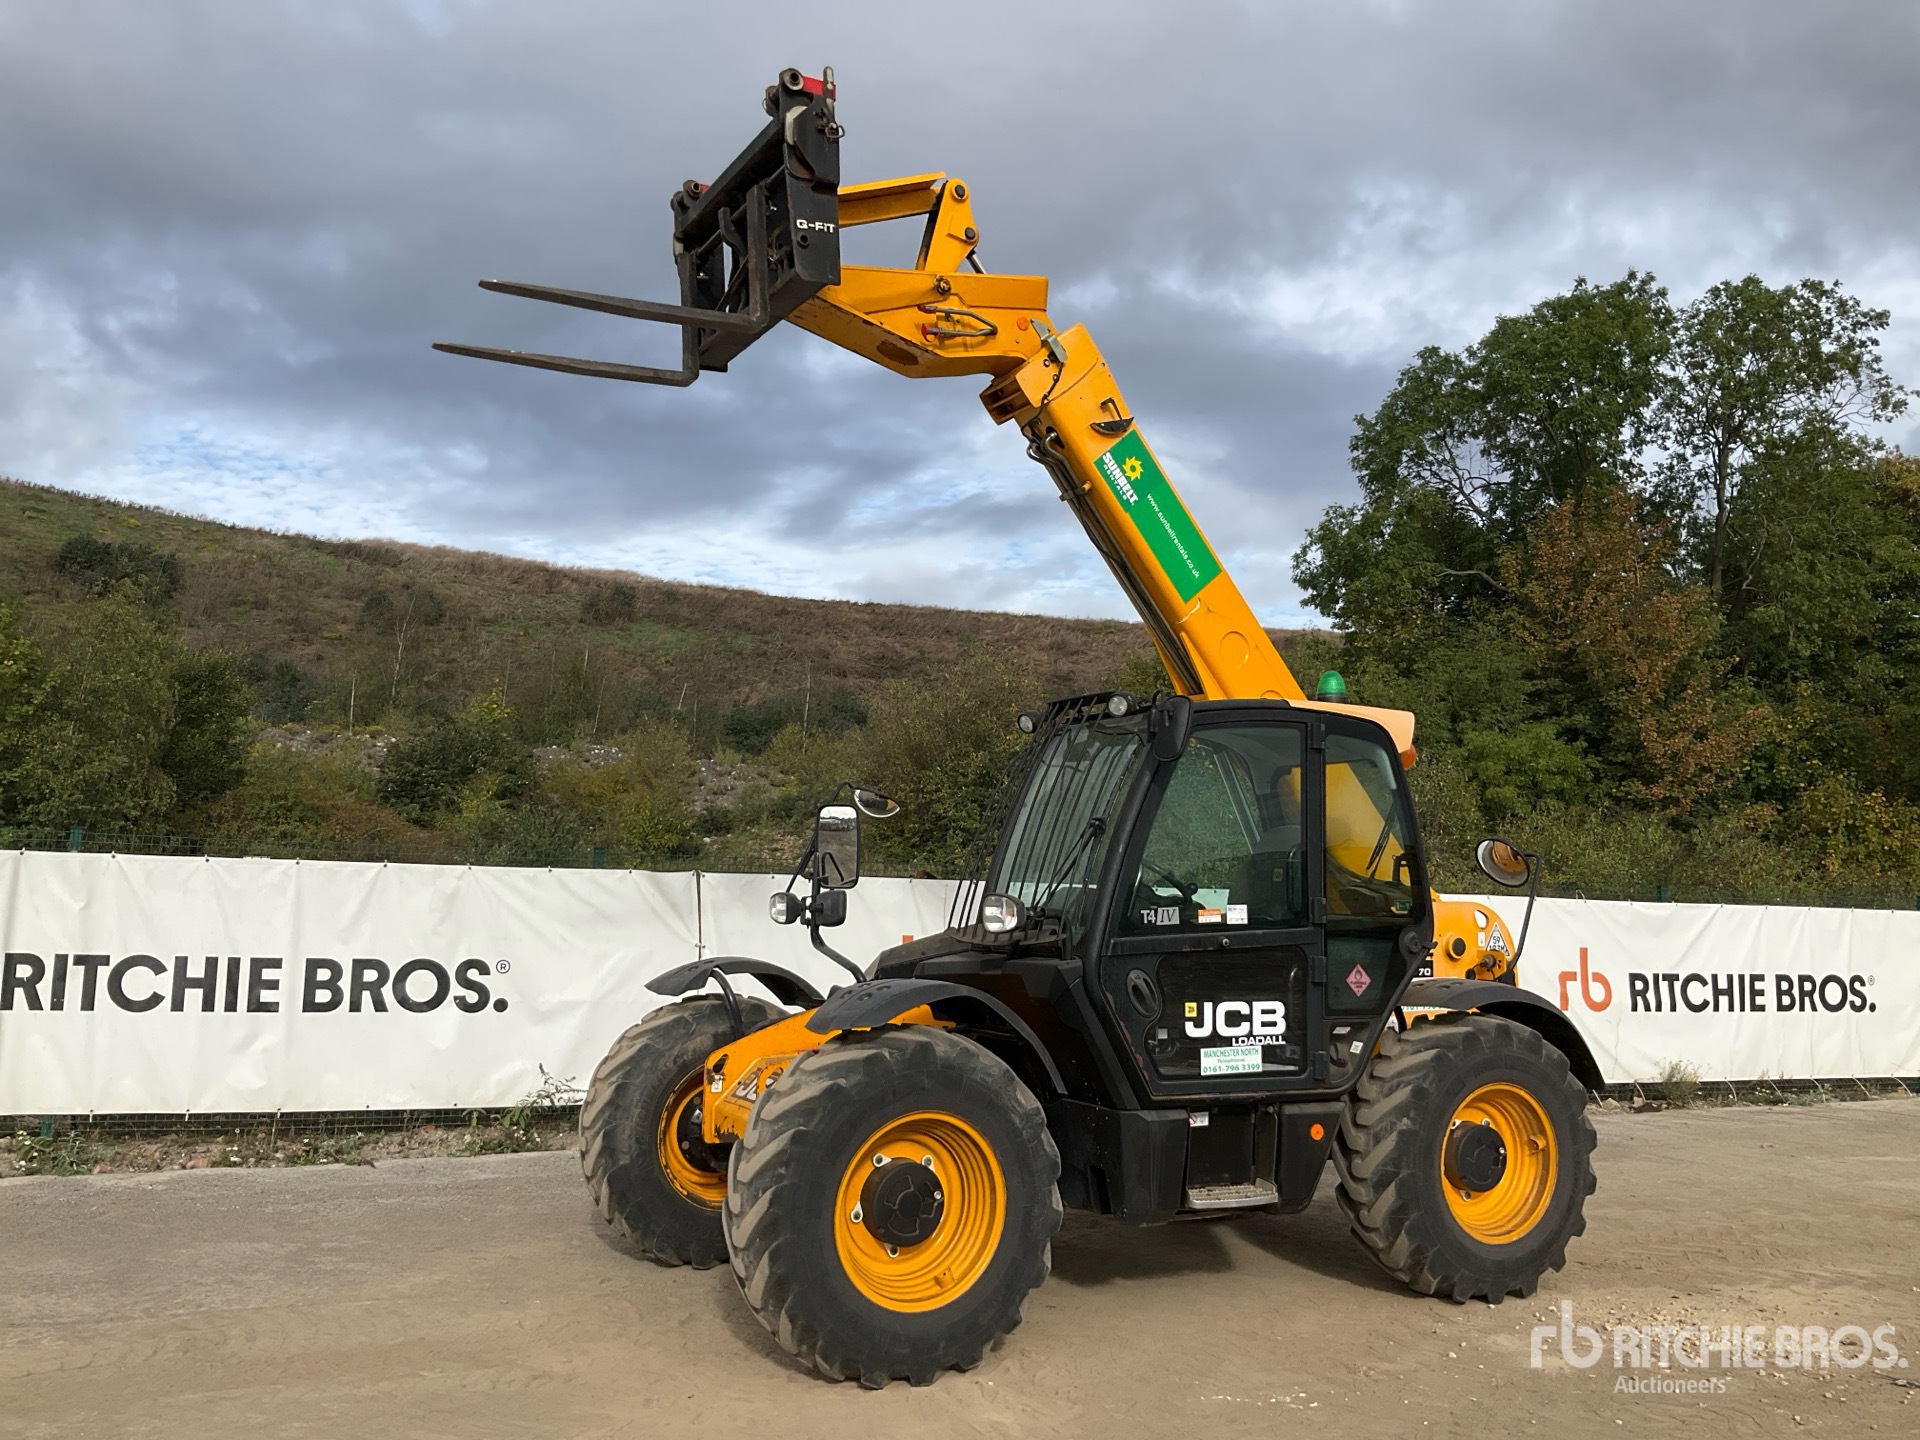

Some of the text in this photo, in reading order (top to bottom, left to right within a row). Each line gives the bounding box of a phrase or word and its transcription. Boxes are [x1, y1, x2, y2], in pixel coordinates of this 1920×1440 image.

[796, 219, 835, 233] Q-FIT
[1102, 451, 1139, 504] SUNBELT
[1103, 464, 1128, 501] RENTALS
[1146, 493, 1200, 579] www.sunbeltrentals.co.uk
[1140, 909, 1156, 924] T4
[0, 952, 284, 1013] RITCHIE
[1628, 972, 1767, 1013] RITCHIE
[1184, 1000, 1287, 1038] JCB
[1203, 1047, 1259, 1059] MANCHESTER NORTH
[1231, 1035, 1287, 1047] LOADALL
[1203, 1063, 1261, 1074] 0161-796 3399
